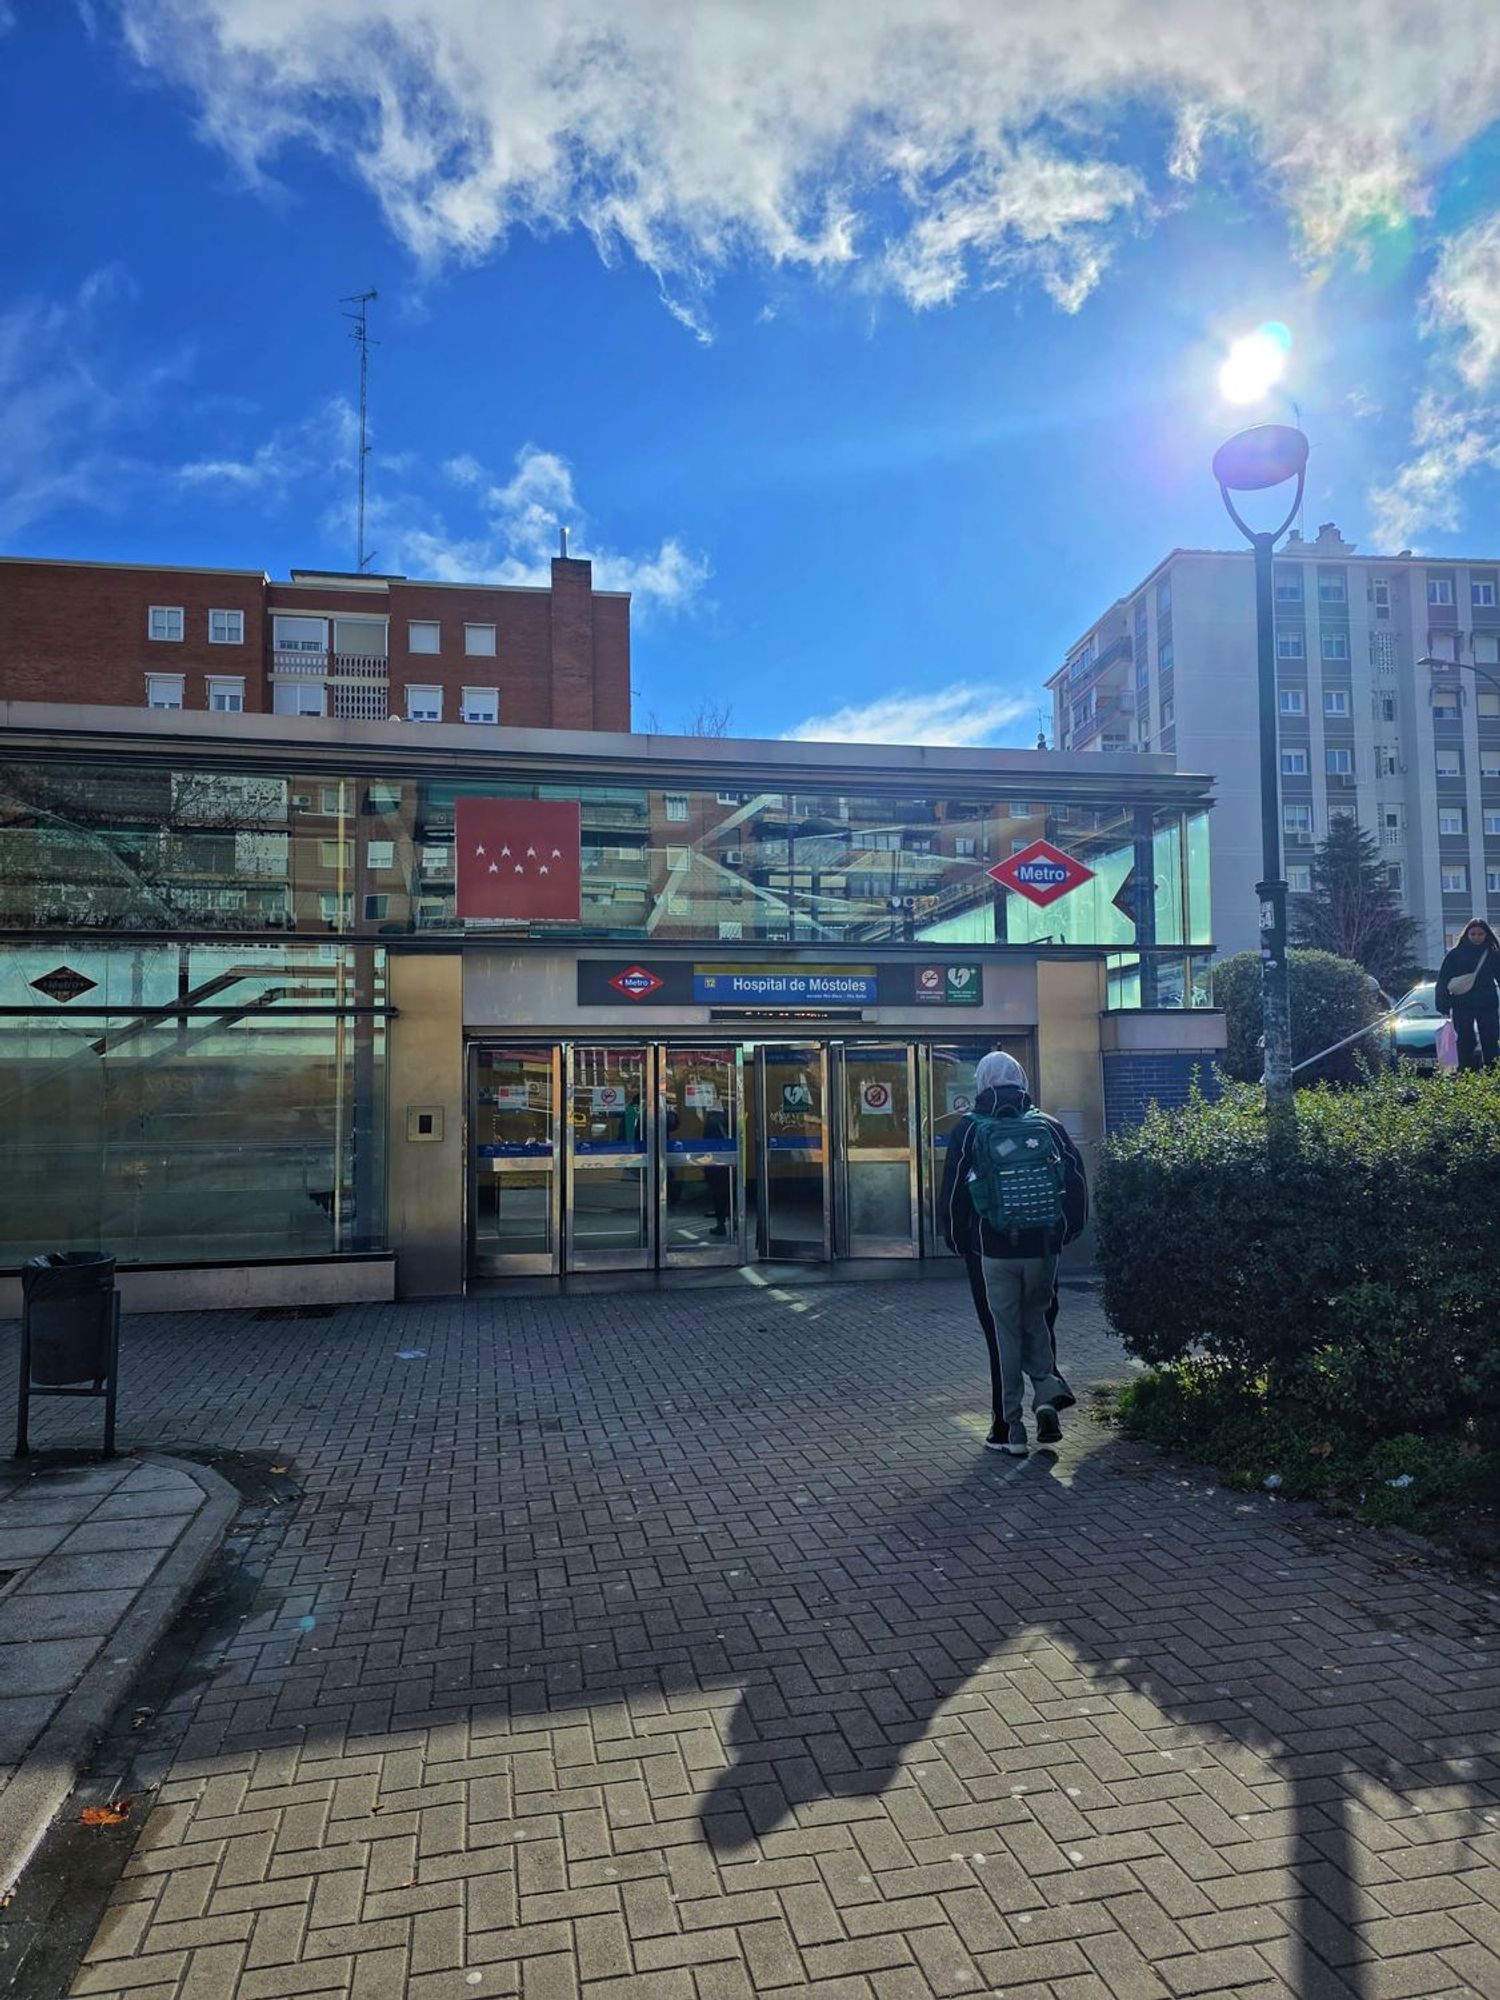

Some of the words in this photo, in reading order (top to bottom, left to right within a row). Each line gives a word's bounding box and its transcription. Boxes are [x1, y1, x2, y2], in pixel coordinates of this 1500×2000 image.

[1020, 865, 1065, 881] Metro
[624, 978, 649, 987] Metro
[733, 977, 787, 993] Hospital
[789, 978, 806, 991] de
[809, 978, 867, 992] Móstoles
